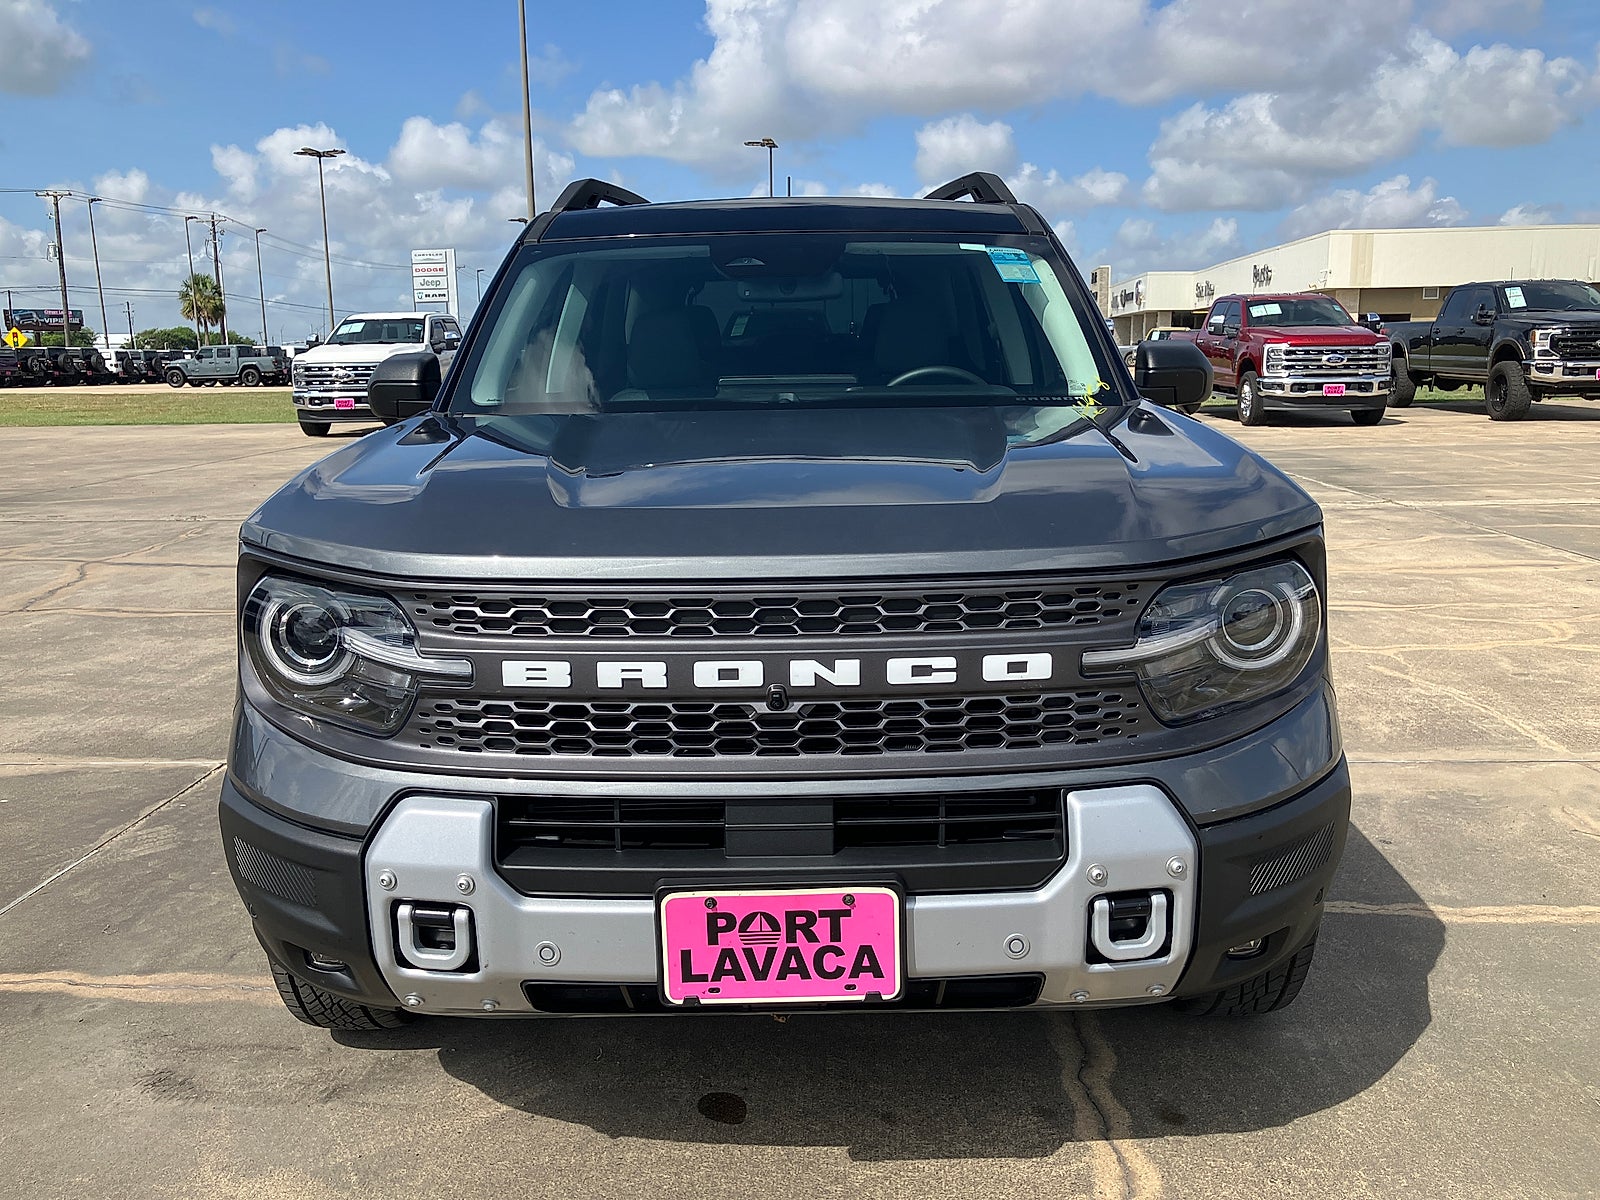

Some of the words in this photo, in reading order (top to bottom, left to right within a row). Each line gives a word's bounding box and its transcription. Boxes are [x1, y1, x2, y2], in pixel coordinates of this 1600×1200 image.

[420, 278, 441, 287] Jeep
[501, 653, 1053, 688] BRONCO
[706, 909, 852, 945] PORT
[680, 945, 885, 983] LAVACA
